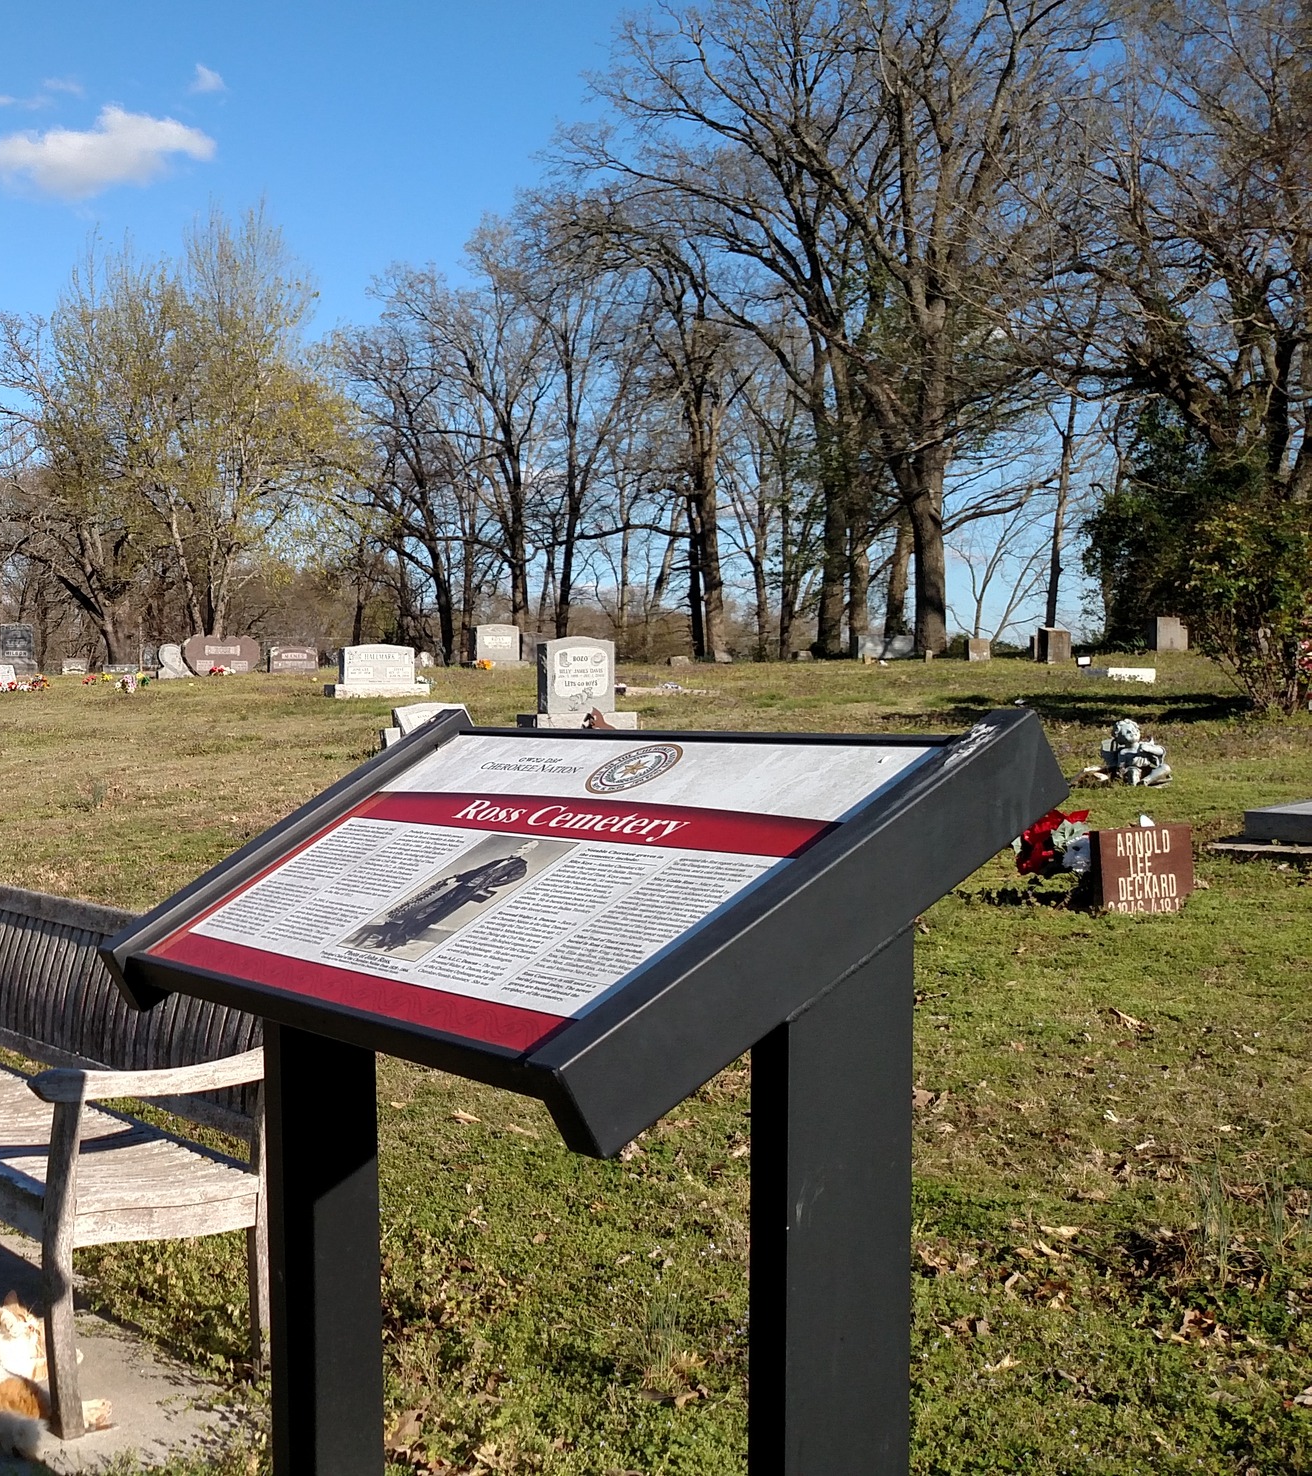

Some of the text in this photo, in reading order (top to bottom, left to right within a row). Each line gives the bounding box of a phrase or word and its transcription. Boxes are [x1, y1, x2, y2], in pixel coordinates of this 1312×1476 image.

[481, 762, 581, 774] CHEROKEE NATION
[451, 800, 691, 842] Ross Cemetery
[1116, 830, 1170, 856] ARNOLD
[1129, 853, 1153, 877] LEE
[1118, 874, 1177, 901] DECKARD
